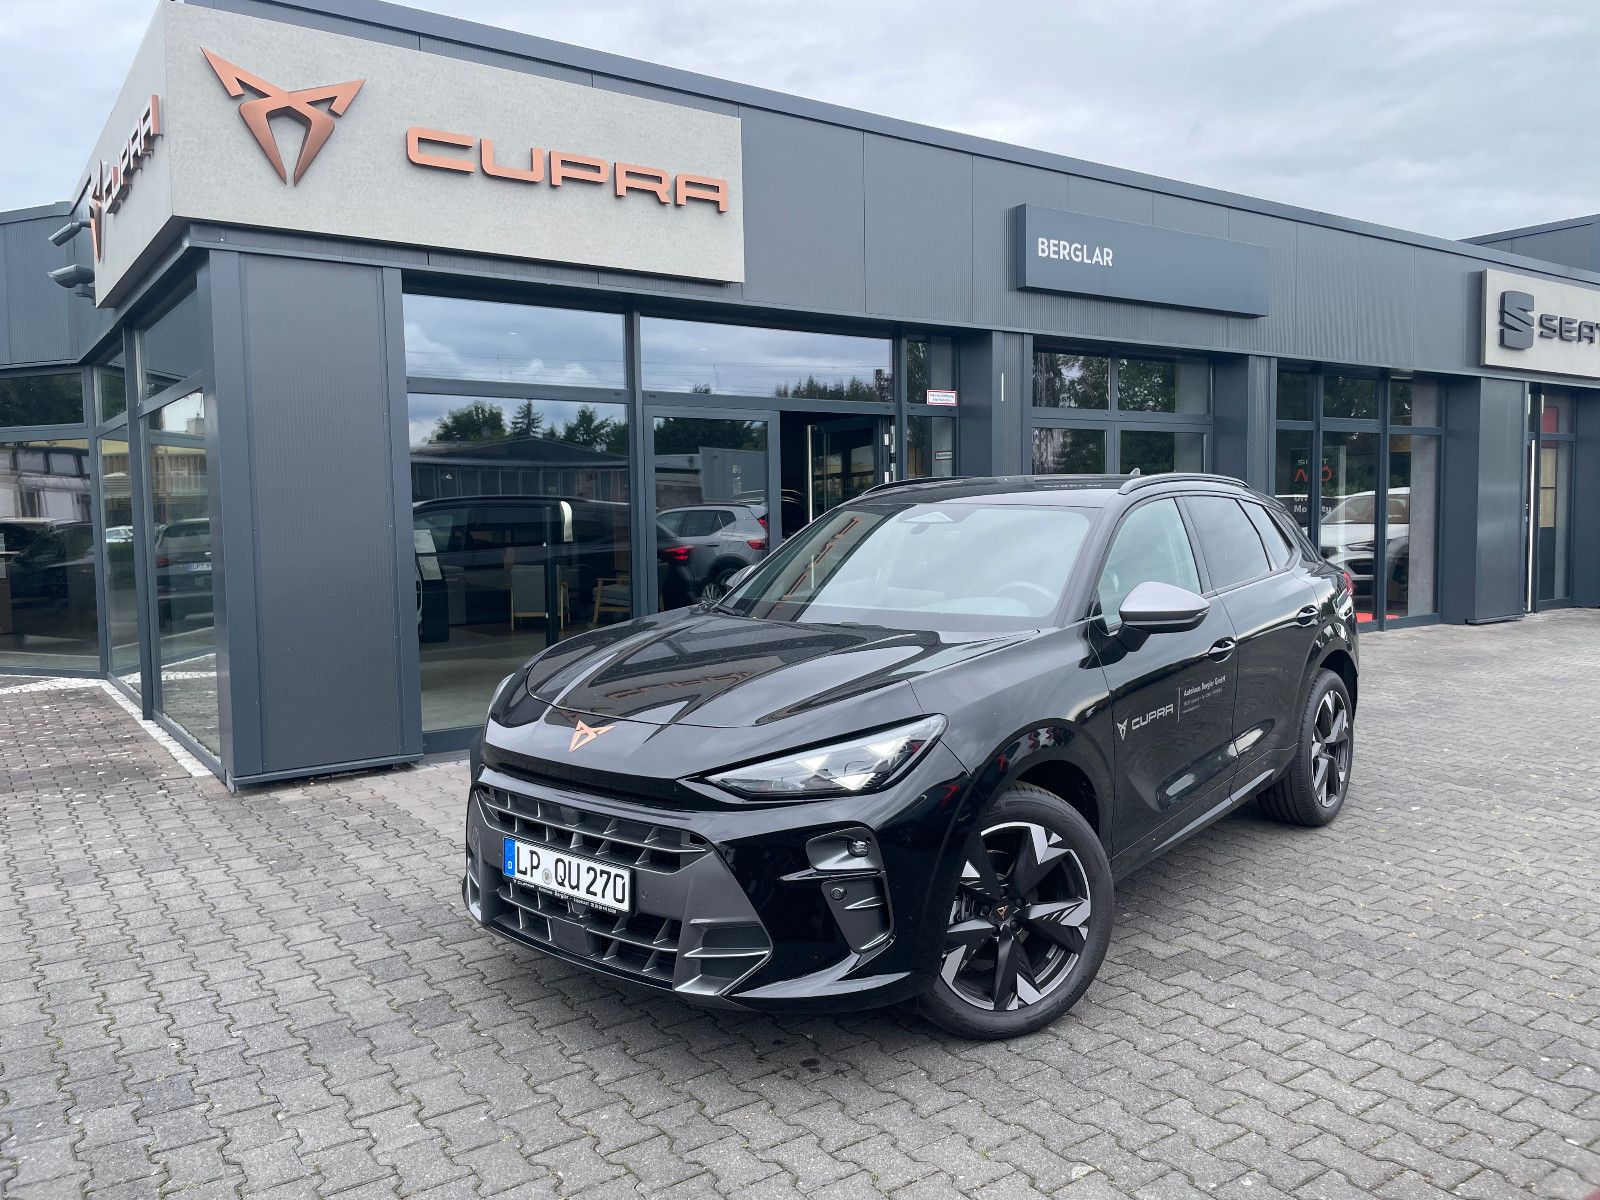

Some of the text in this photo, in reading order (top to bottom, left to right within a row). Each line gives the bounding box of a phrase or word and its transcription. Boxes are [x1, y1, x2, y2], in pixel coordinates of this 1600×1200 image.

[405, 127, 728, 213] CUPRA
[1038, 237, 1113, 267] BERGLAR
[1539, 313, 1600, 345] SEA
[1293, 504, 1332, 514] Moty
[1131, 703, 1174, 730] CUPRA
[516, 845, 626, 904] LP QU 270
